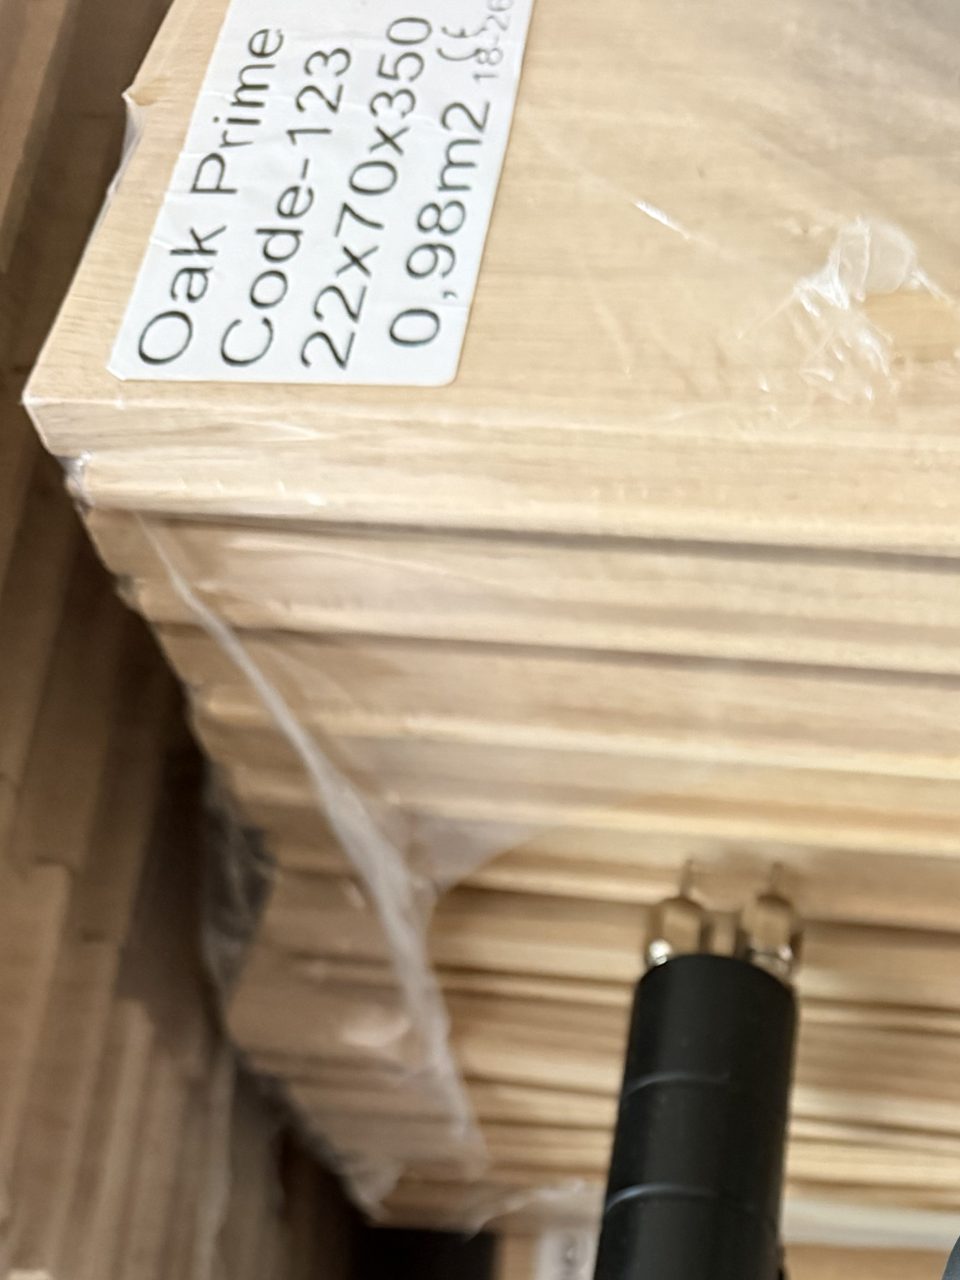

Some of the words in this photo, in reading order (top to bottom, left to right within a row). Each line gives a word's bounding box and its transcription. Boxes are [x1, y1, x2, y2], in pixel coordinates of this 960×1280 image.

[137, 224, 228, 366] Oak
[190, 27, 285, 195] Prime
[219, 46, 353, 368] Code-123
[300, 16, 433, 370] 22x70x350
[388, 101, 491, 347] 0,98m2
